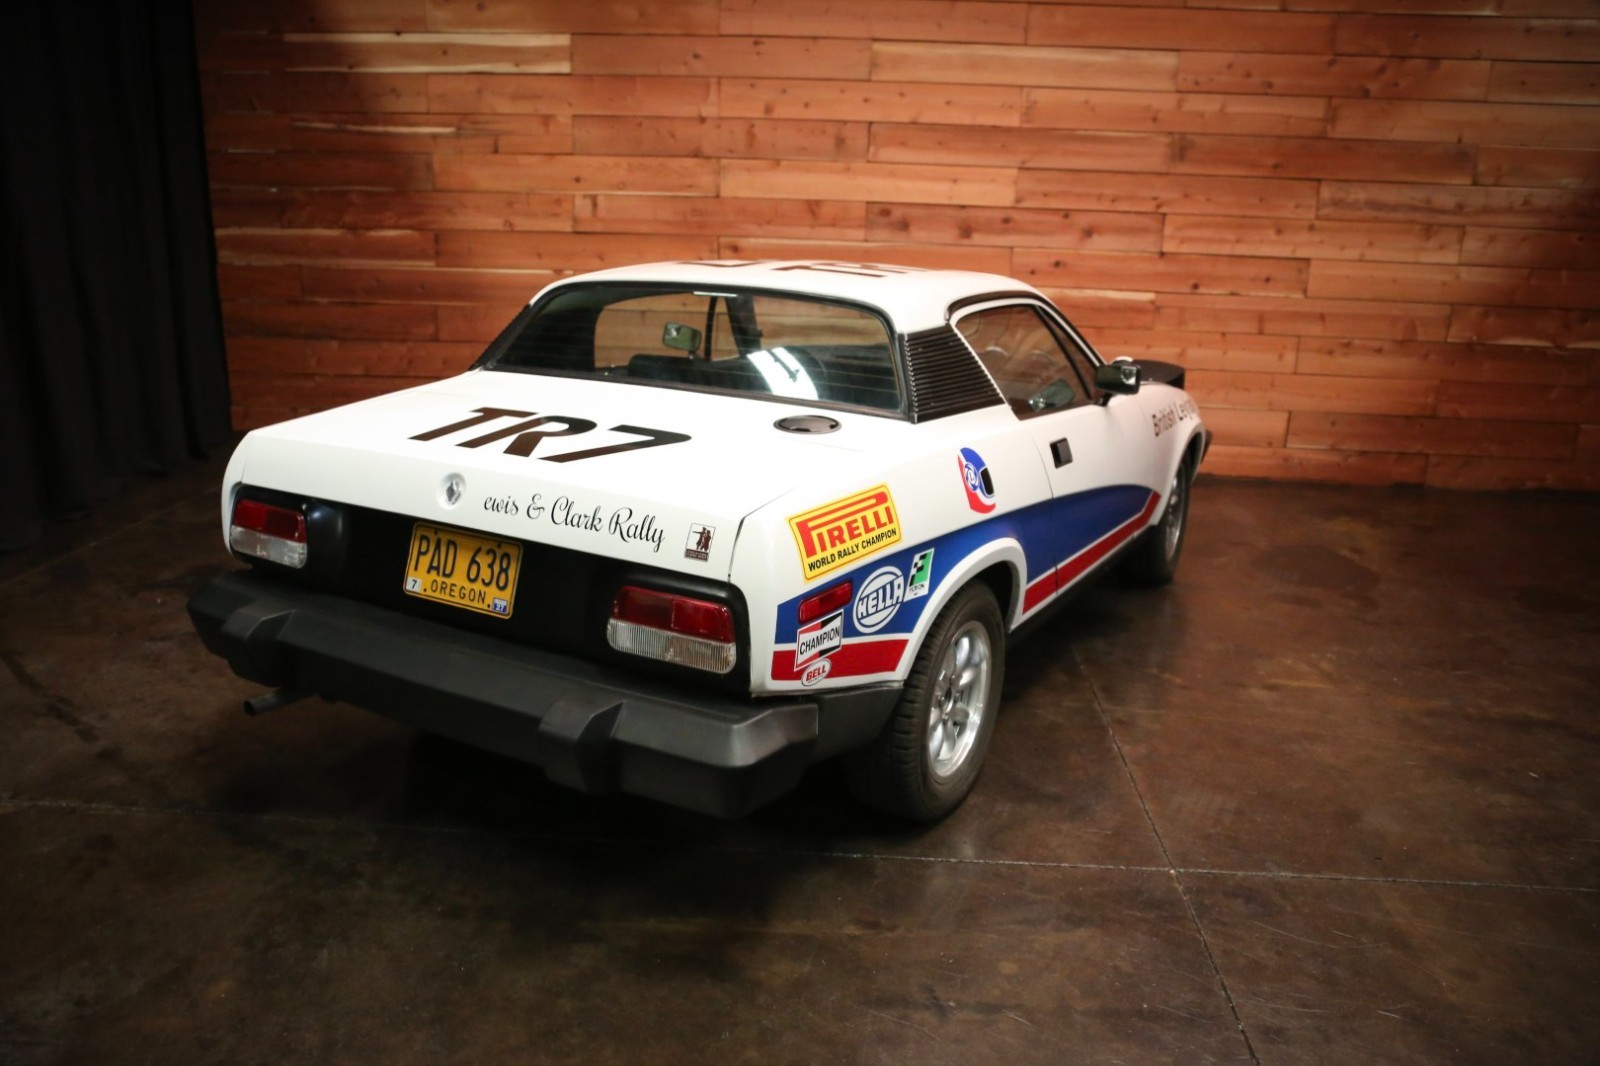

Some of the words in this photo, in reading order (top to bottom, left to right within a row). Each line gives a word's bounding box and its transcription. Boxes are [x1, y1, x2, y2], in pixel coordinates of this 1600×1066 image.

[407, 407, 692, 463] TR7
[483, 495, 519, 516] ewis
[526, 493, 545, 519] &
[550, 496, 603, 532] Clark
[608, 507, 666, 553] Rally
[795, 490, 894, 559] PIRELLI
[413, 534, 458, 578] PAD
[466, 546, 511, 592] 638
[808, 553, 836, 572] WORLD
[837, 544, 859, 561] RALLY
[861, 528, 897, 550] CHAMPION
[411, 580, 418, 589] 7
[430, 578, 486, 605] OREGON
[857, 575, 905, 619] HELLA
[799, 625, 841, 656] CHAMPION
[805, 664, 827, 682] BELL
